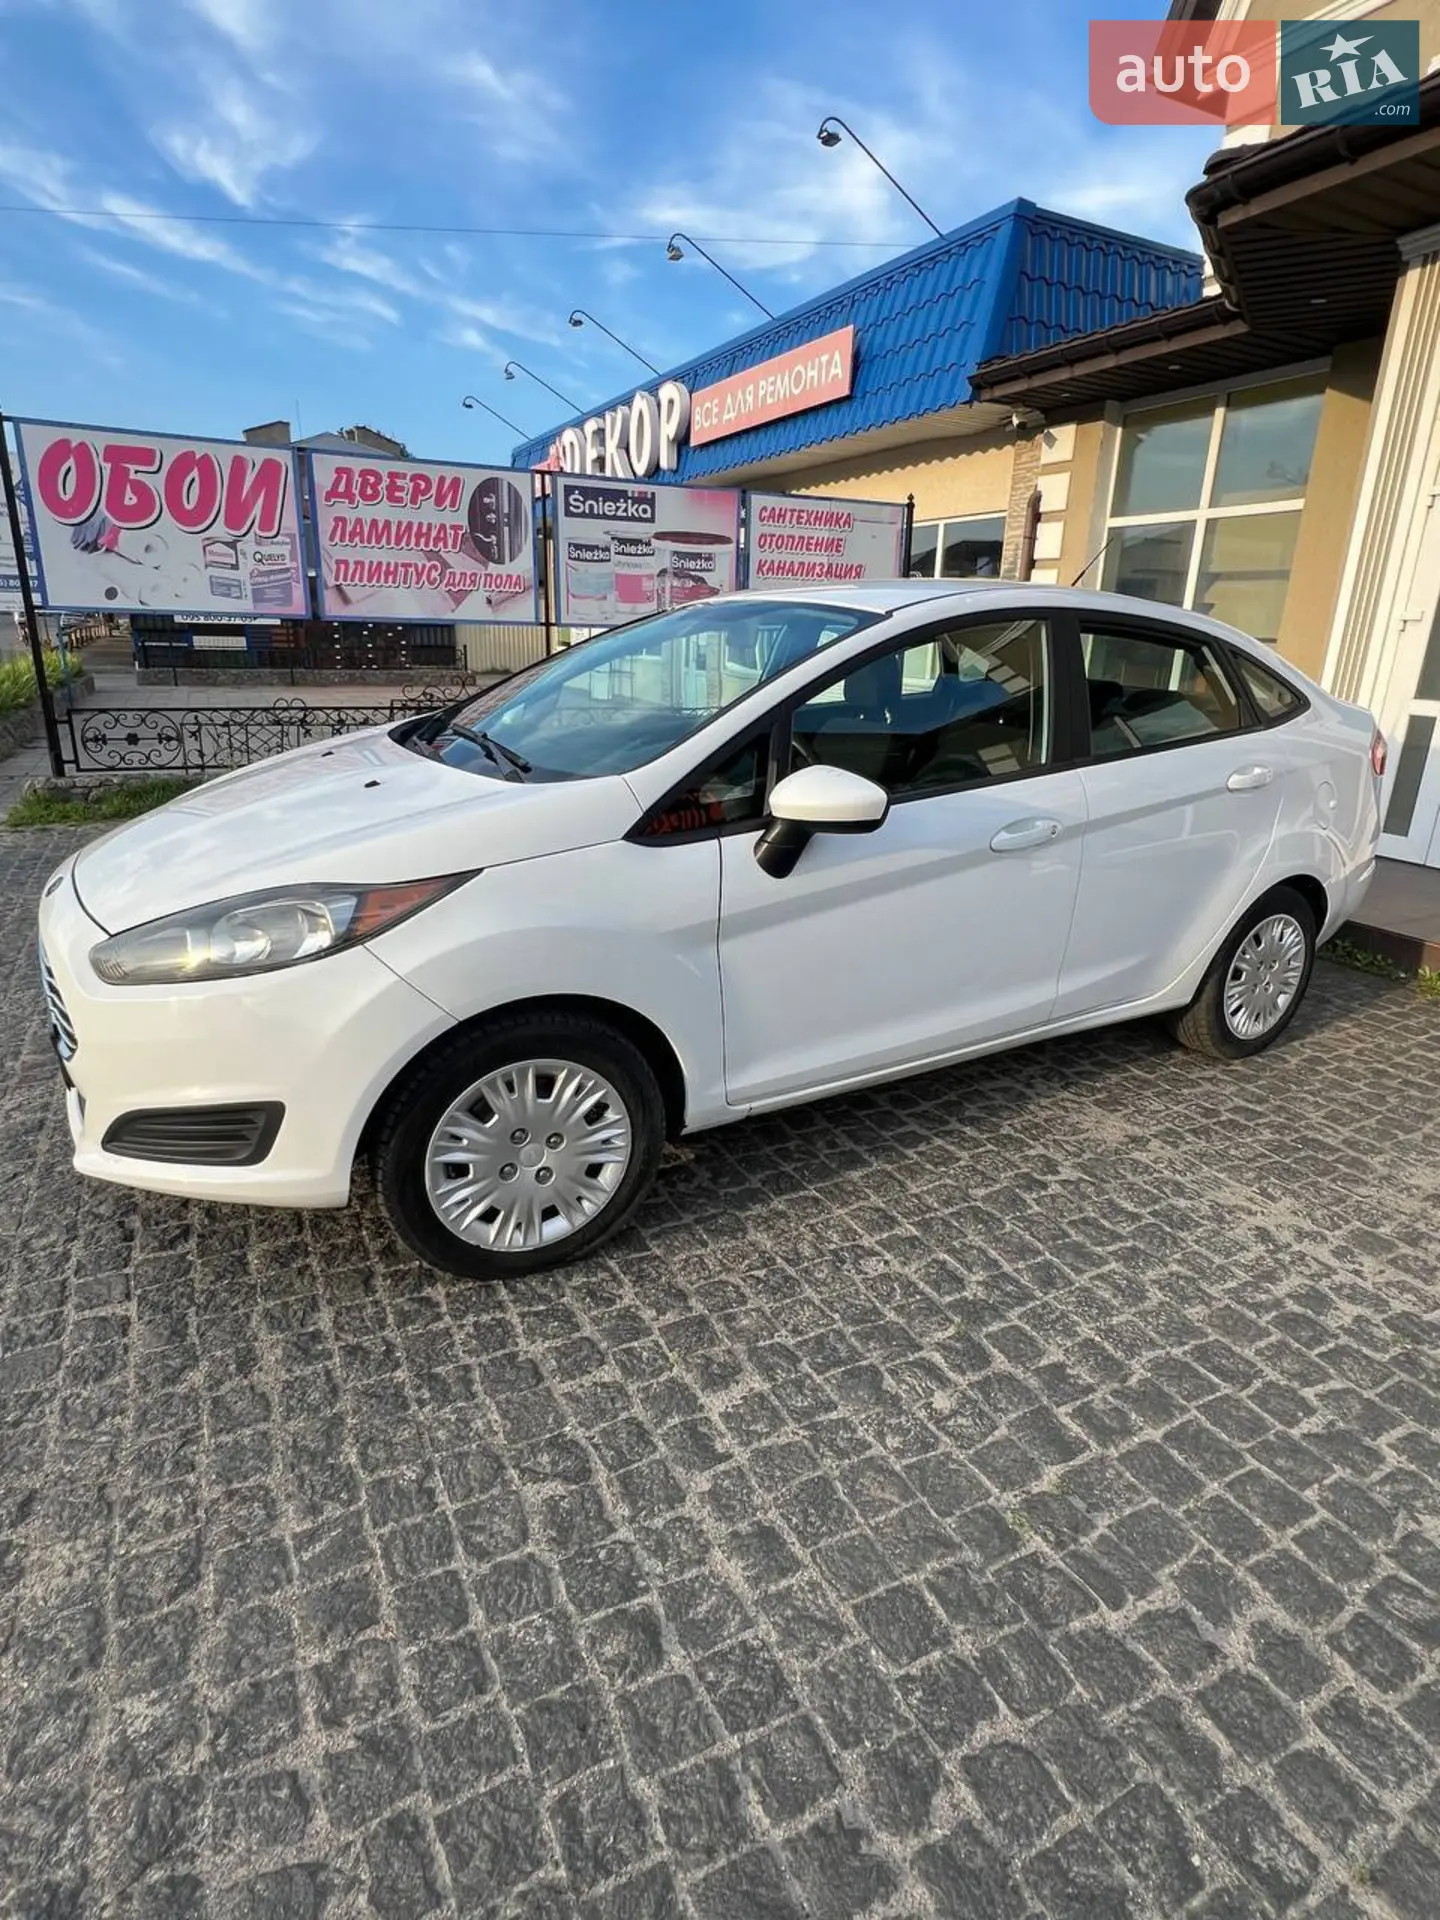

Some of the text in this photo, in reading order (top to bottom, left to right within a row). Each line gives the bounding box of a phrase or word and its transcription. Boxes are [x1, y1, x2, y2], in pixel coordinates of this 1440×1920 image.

[694, 349, 842, 432] ВСЕ ДЛЯ РЕМОНТА
[37, 438, 288, 538] ОБОИ
[324, 467, 464, 511] ДВЕРИ
[568, 489, 652, 519] Śnieżka
[328, 515, 465, 551] ЛАМИНАТ
[758, 505, 854, 531] САНТЕХНИКА
[757, 533, 845, 554] ОТОПЛЕНИЕ
[333, 558, 442, 590] ПЛИНТУС
[756, 559, 867, 580] КАНАЛИЗАЦИЯ
